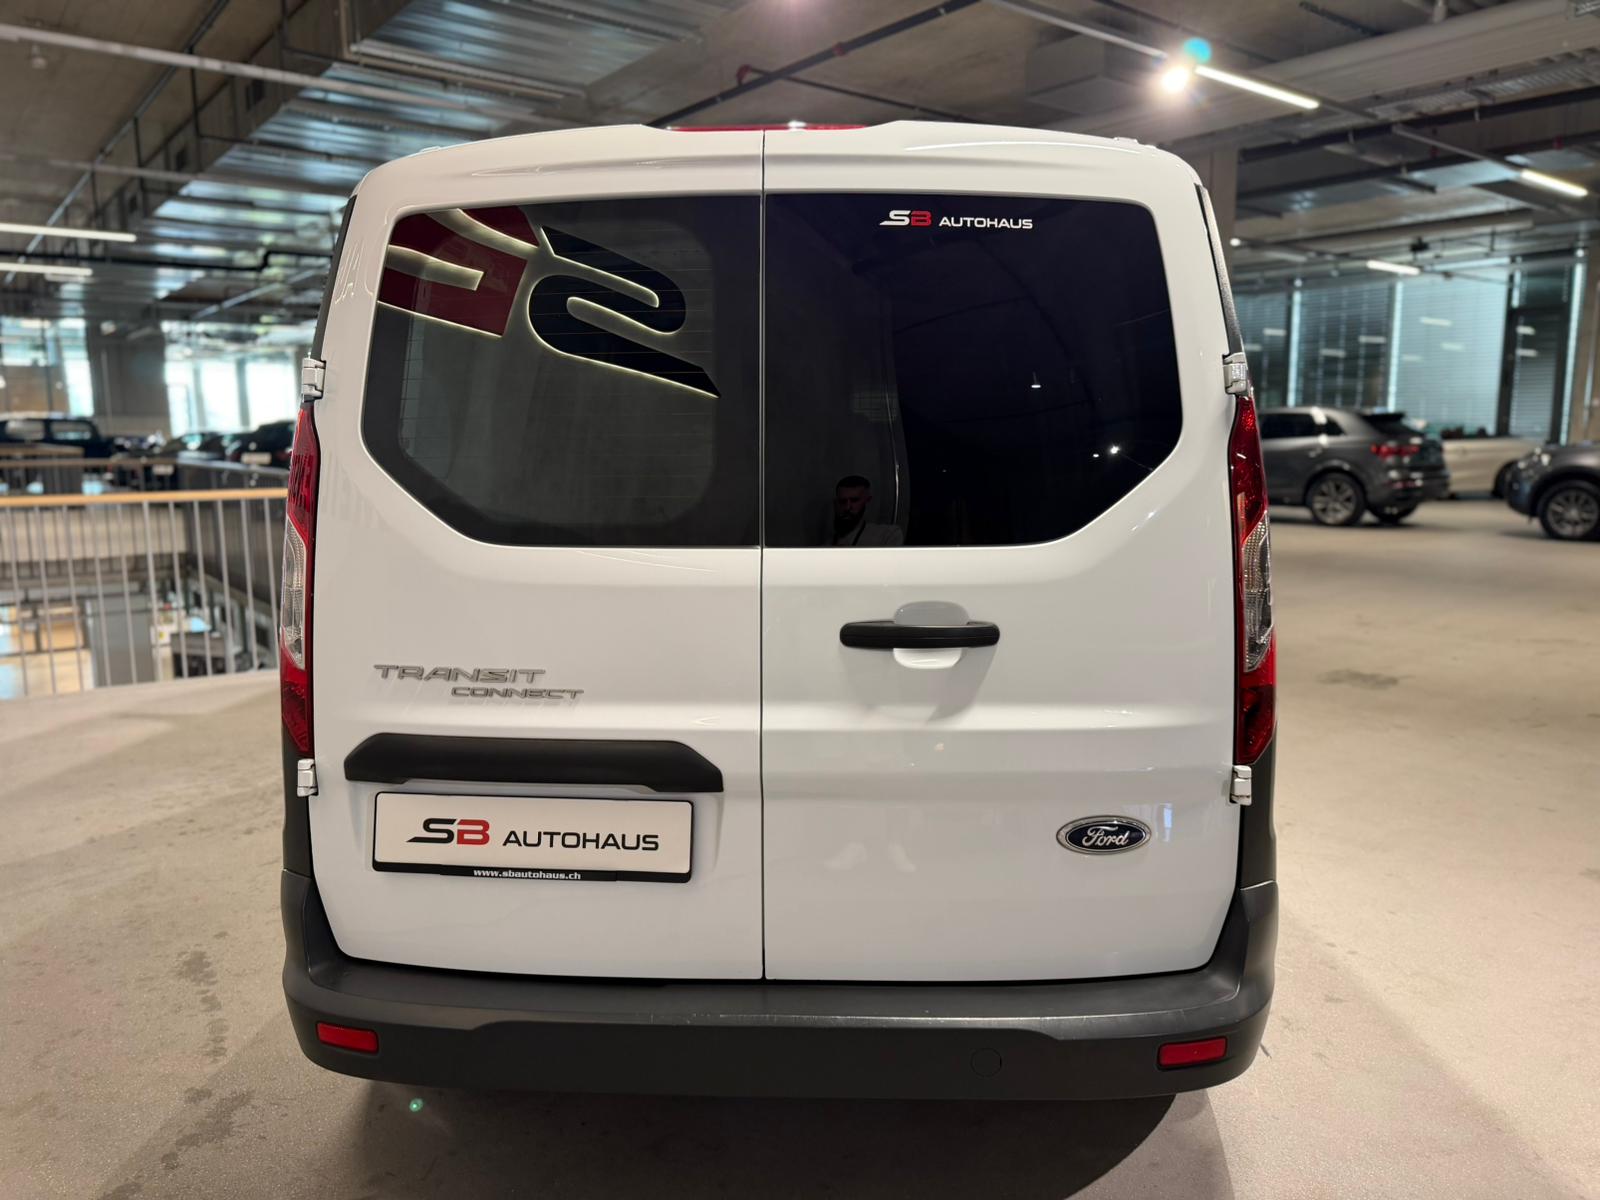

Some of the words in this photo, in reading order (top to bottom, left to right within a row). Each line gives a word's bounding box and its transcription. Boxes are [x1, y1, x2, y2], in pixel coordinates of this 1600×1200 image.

[880, 209, 931, 226] SB
[939, 215, 1032, 229] AUTOHAUS
[374, 664, 546, 684] TRANSIT
[451, 687, 584, 700] CONNECT
[406, 817, 490, 846] SB
[502, 829, 660, 851] AUTOHAUS
[1082, 826, 1130, 846] Ford
[473, 869, 581, 881] www.sbautohaus.ch
